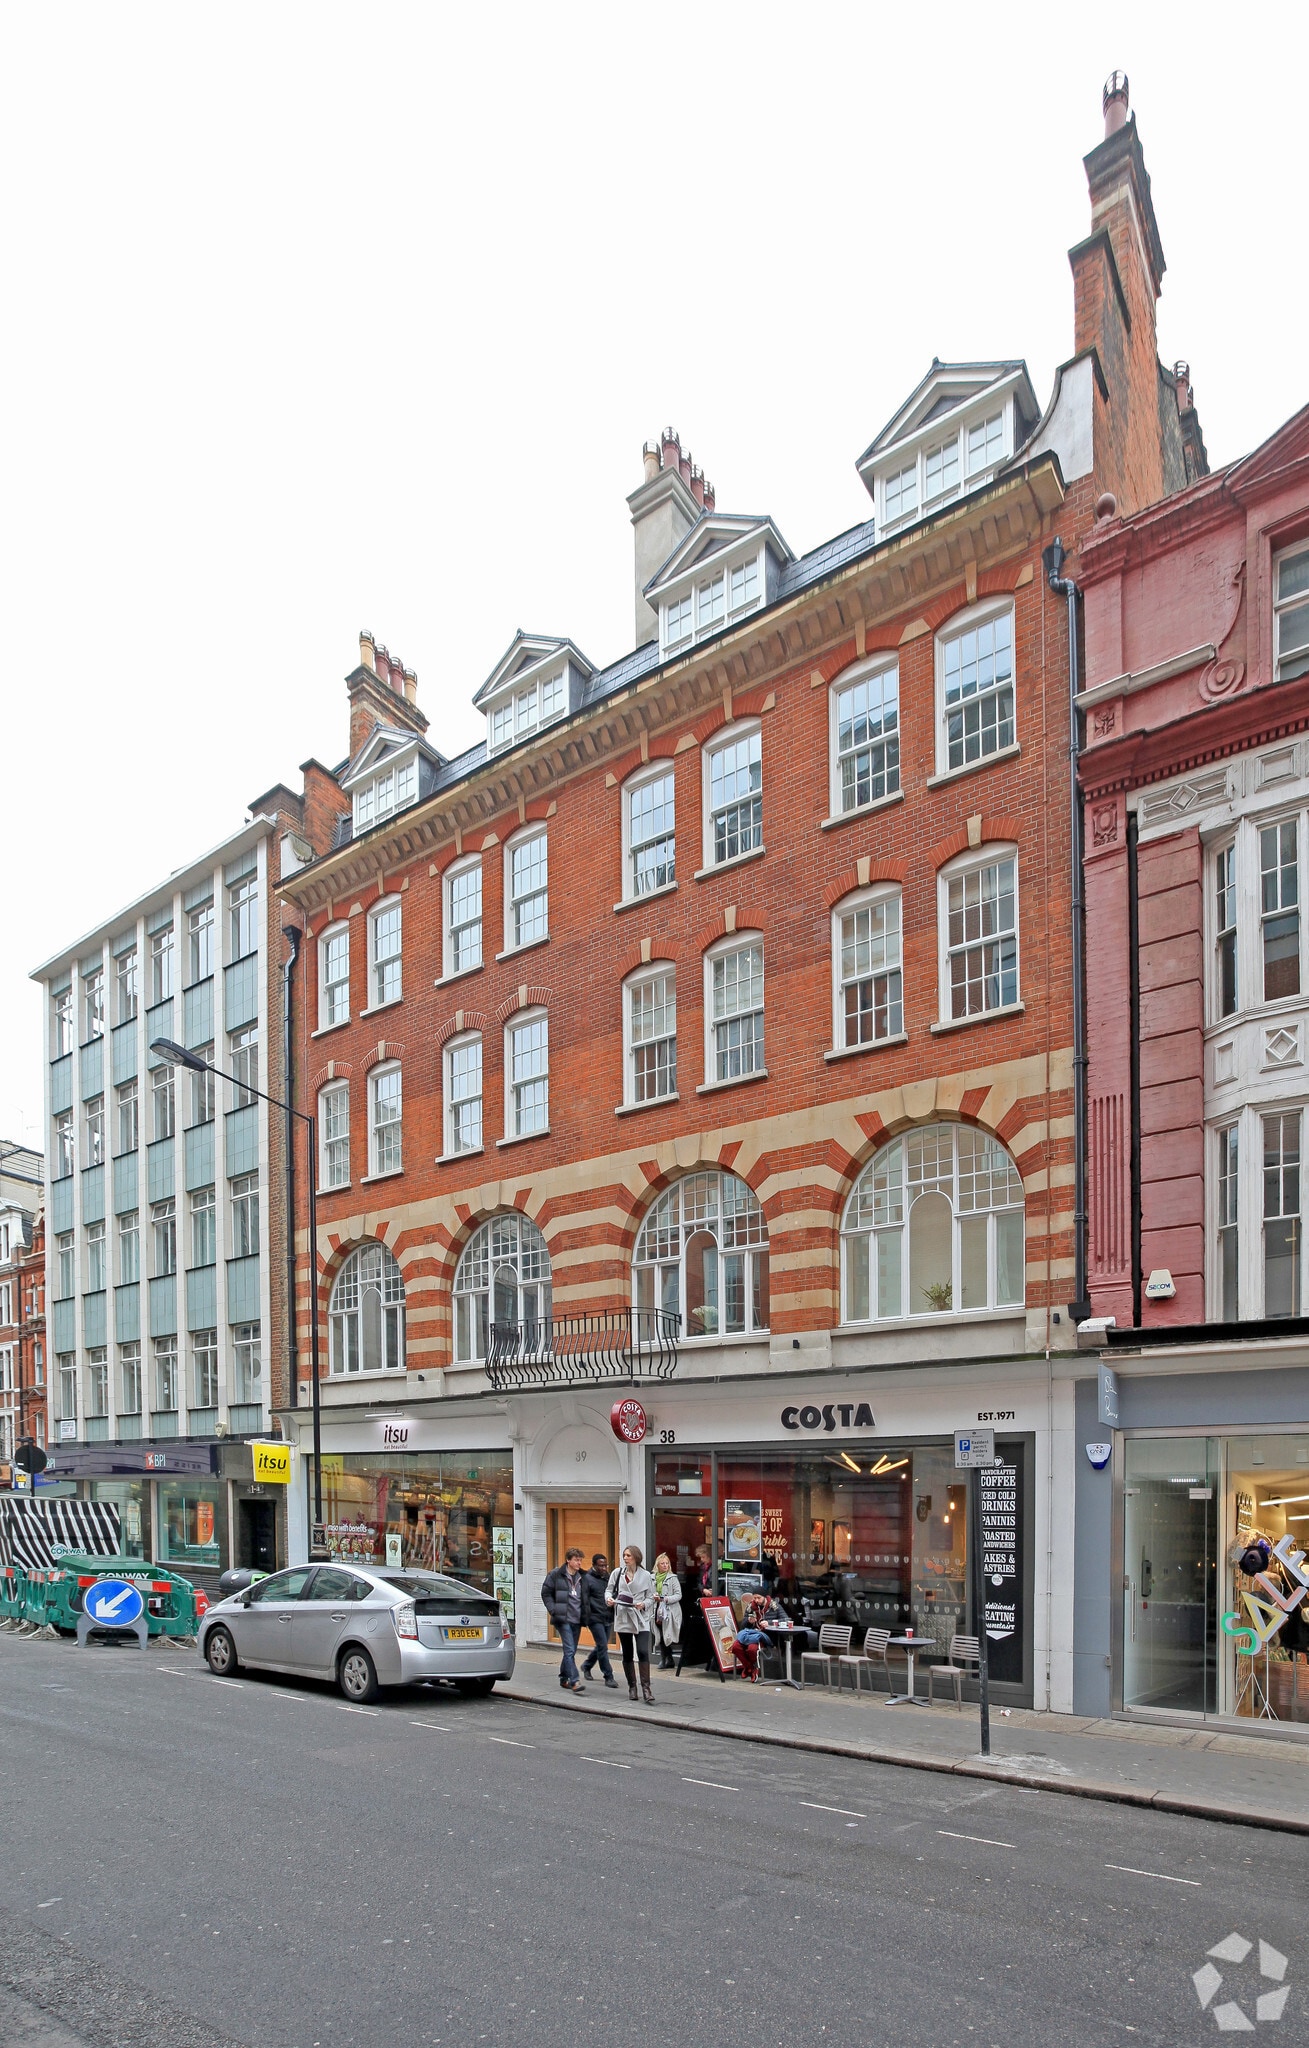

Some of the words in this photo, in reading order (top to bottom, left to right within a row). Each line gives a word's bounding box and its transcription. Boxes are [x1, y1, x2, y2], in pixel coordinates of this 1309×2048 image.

[623, 1403, 641, 1416] COSTA
[781, 1403, 876, 1432] COSTA
[384, 1424, 408, 1443] itsu
[621, 1423, 643, 1439] COFFEE
[660, 1430, 675, 1443] 38
[961, 1440, 969, 1451] P
[154, 1454, 166, 1467] BPI
[258, 1453, 287, 1470] itsu
[575, 1451, 587, 1462] 39
[981, 1476, 1016, 1487] COFFEE
[998, 1492, 1016, 1500] COLD
[765, 1509, 782, 1517] SWEET
[770, 1518, 783, 1532] OF
[983, 1541, 1016, 1549] ANDWICHES
[984, 1553, 1006, 1564] AKES
[1008, 1554, 1016, 1564] &
[984, 1563, 1016, 1573] ASTRIES
[1221, 1534, 1309, 1656] SALE
[985, 1611, 1015, 1623] EATING
